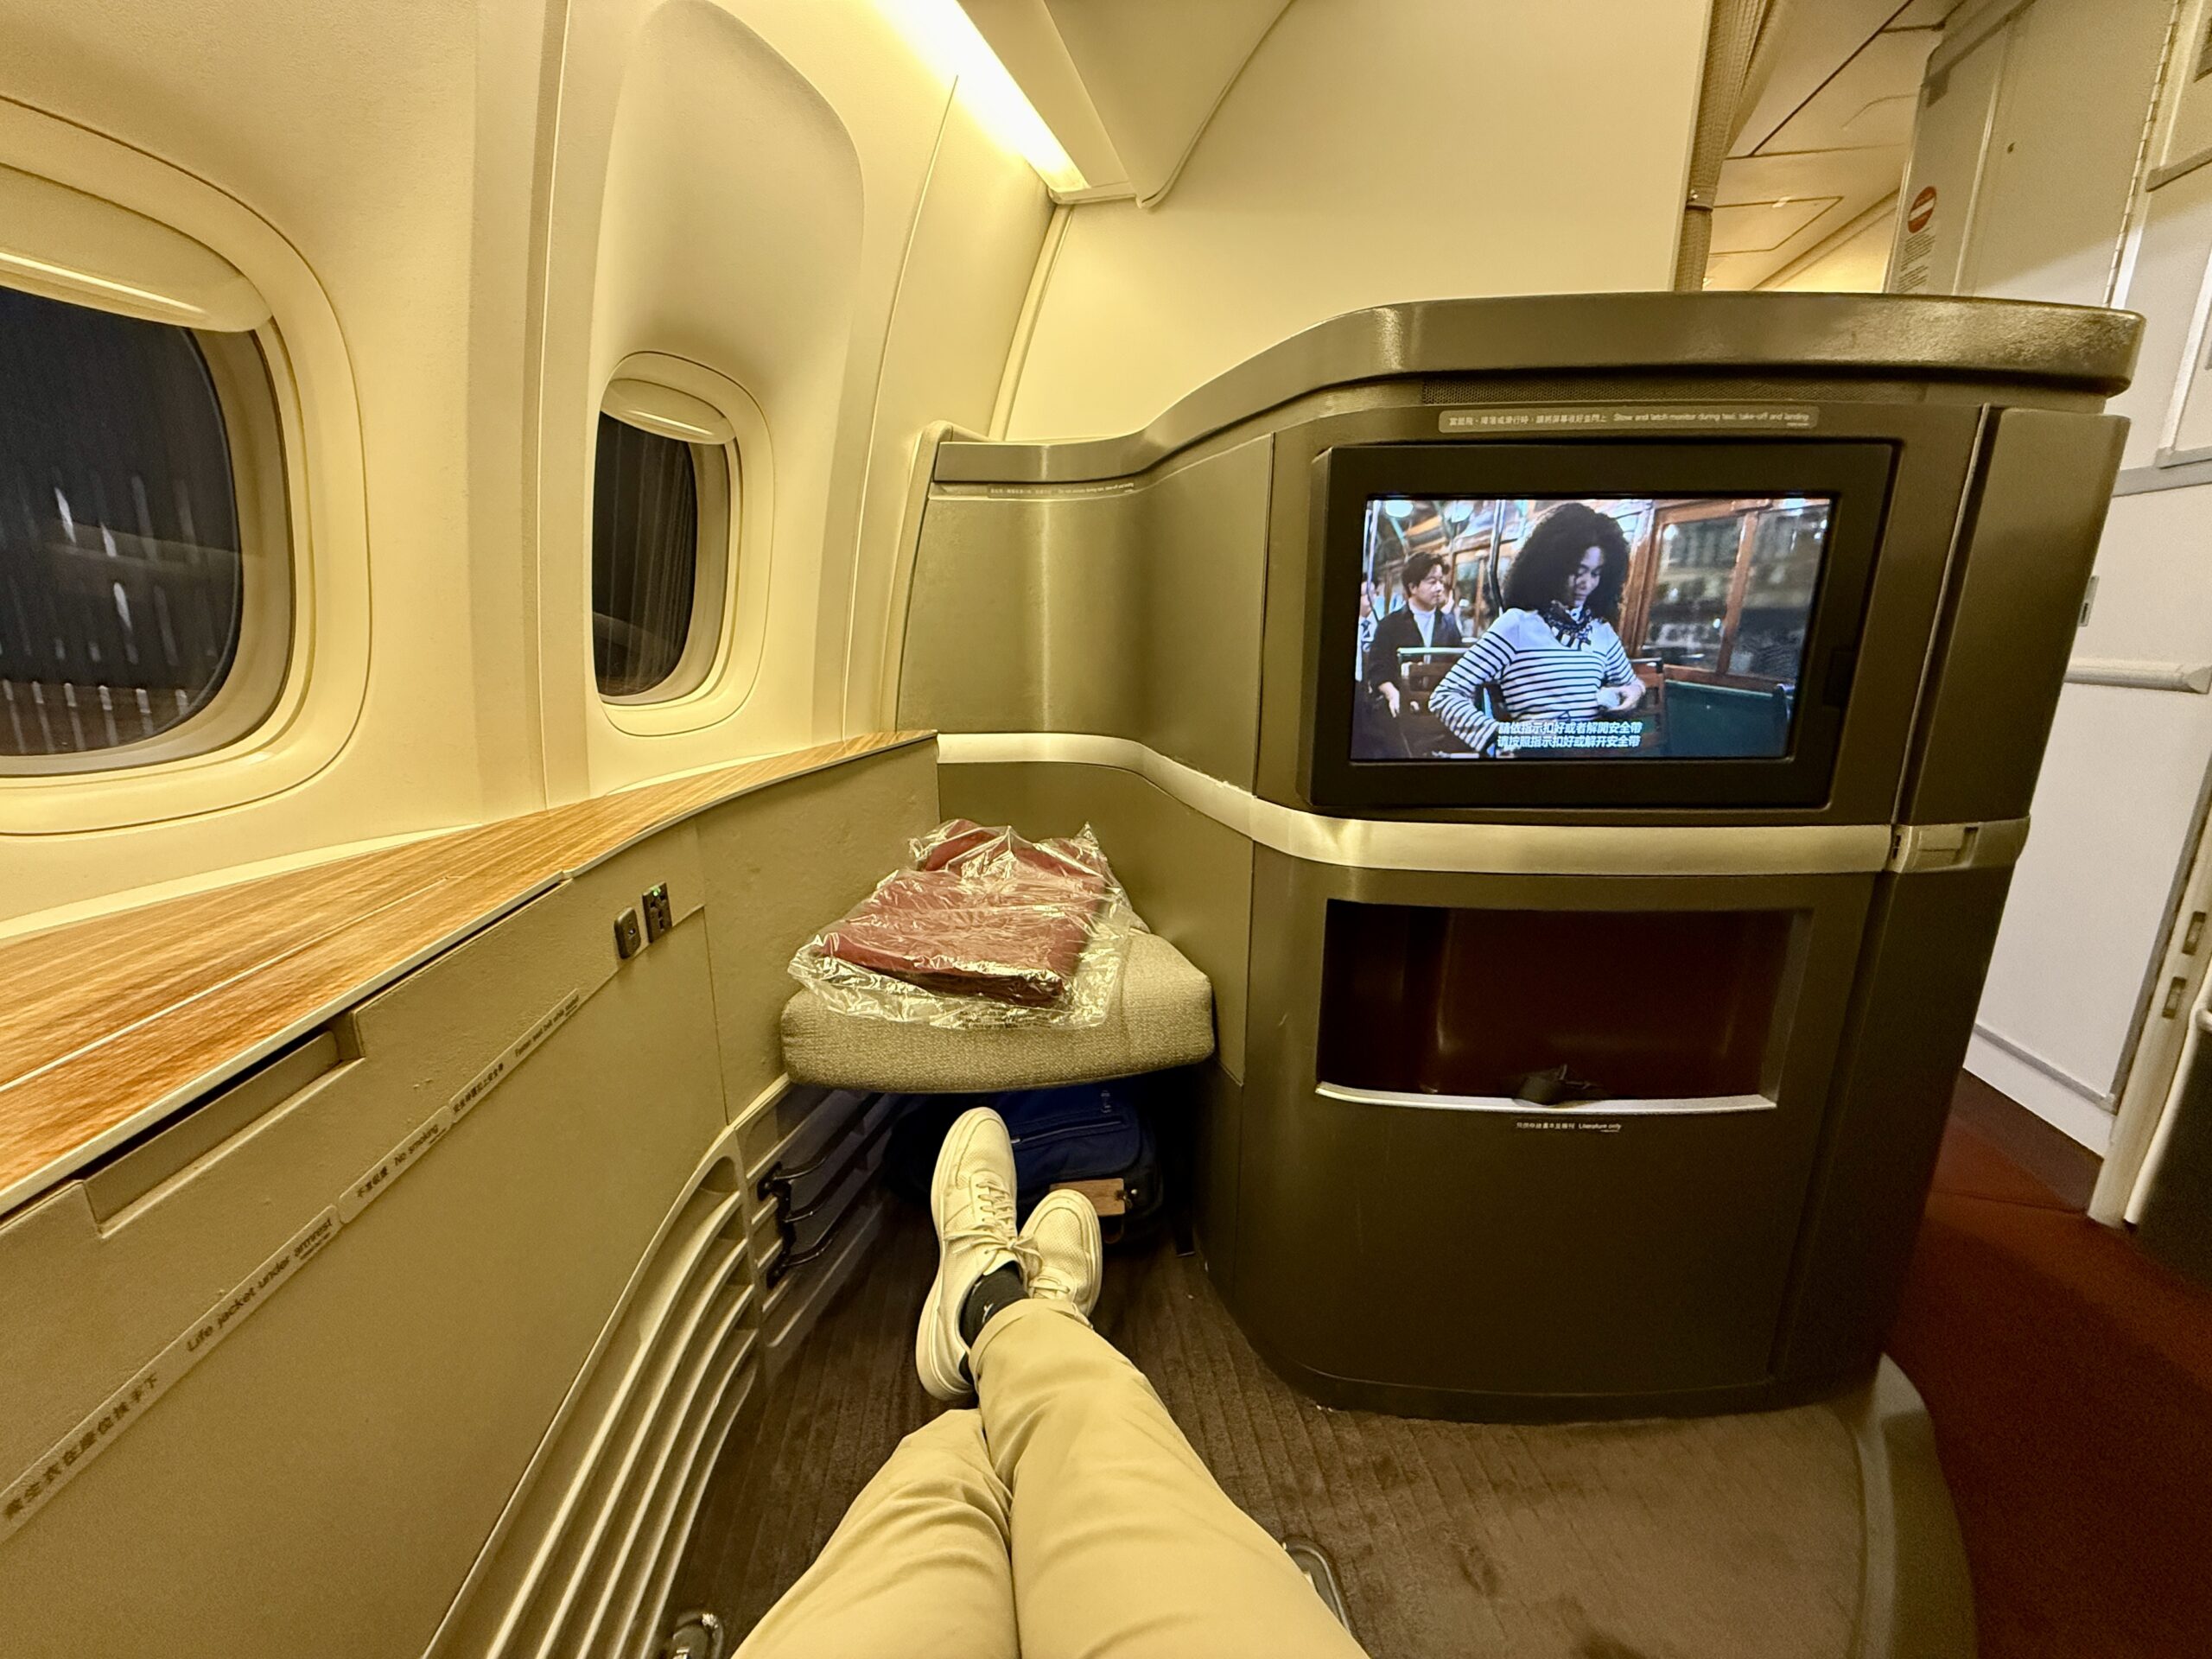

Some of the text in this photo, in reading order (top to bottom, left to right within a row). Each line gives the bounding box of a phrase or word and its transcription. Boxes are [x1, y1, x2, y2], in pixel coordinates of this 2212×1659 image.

[1697, 413, 1720, 422] during
[1784, 412, 1809, 422] landing
[393, 1152, 407, 1166] No
[408, 1124, 439, 1154] smoking
[186, 1325, 213, 1352] Life
[218, 1287, 257, 1328] jacket
[258, 1255, 290, 1289] under
[294, 1218, 334, 1257] armrest
